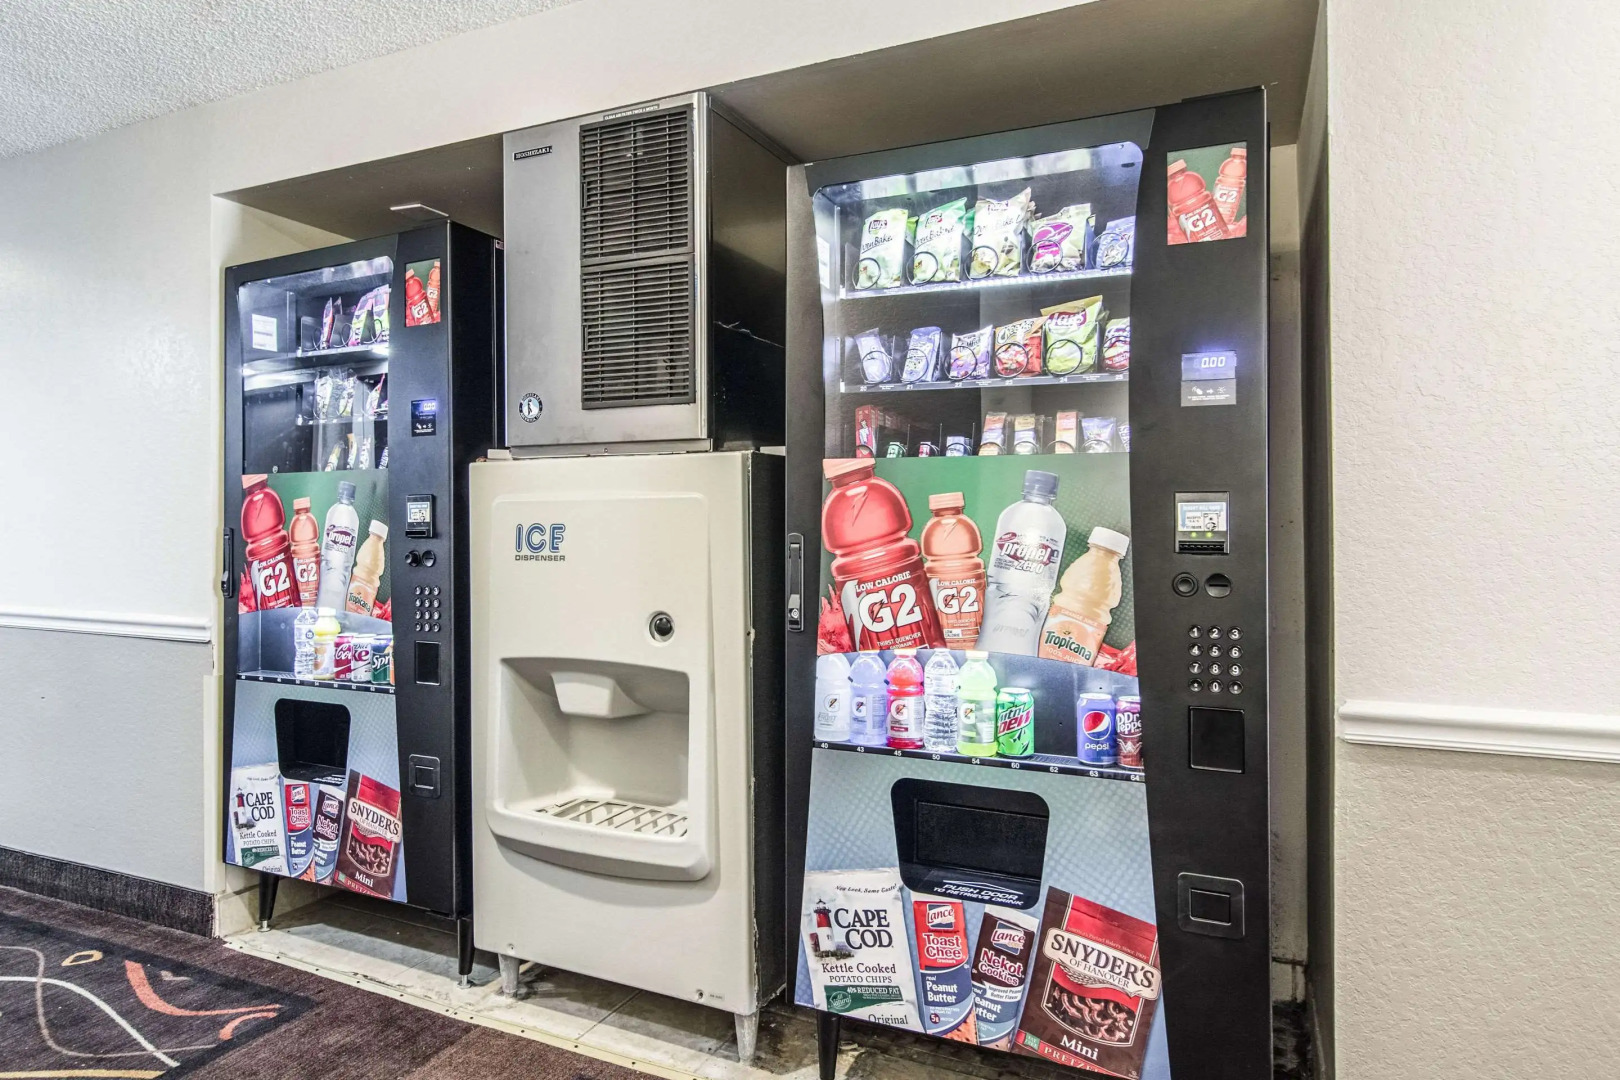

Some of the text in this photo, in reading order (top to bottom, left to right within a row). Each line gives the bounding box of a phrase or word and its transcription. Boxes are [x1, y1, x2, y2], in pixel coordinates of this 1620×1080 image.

[1217, 189, 1238, 203] G2
[1187, 208, 1217, 232] G2
[515, 523, 566, 553] ICE
[515, 554, 566, 562] DISPENSER
[1000, 542, 1052, 562] propel
[297, 562, 318, 583] G2
[1015, 559, 1045, 574] zero
[260, 561, 291, 597] G2
[855, 570, 912, 592] LOW CALORIE
[951, 578, 976, 586] CALORIE
[348, 592, 371, 613] Tropicana
[859, 584, 923, 633] G2
[937, 586, 979, 615] G2
[877, 631, 922, 647] THIRST QUENCHER
[1192, 628, 1239, 639] 1 2 3
[1043, 630, 1092, 661] Tropicana
[1192, 645, 1239, 657] 4 5 6
[1193, 663, 1239, 674] 7 8 9
[1212, 682, 1219, 691] 0
[852, 696, 867, 718] G
[890, 699, 909, 721] G
[961, 703, 977, 724] G
[1124, 711, 1140, 723] Dr
[1084, 742, 1110, 752] pepsi
[246, 791, 274, 808] CAPE
[251, 806, 275, 822] COD
[289, 806, 308, 817] Toast
[350, 801, 400, 836] SNYDER'S
[290, 815, 308, 826] Chee
[316, 815, 339, 834] Nekot
[240, 830, 277, 840] Kettle Cooked
[355, 870, 374, 888] Mini
[943, 884, 1019, 901] PUSH DOOR
[946, 888, 992, 901] RETRIEVE
[991, 896, 1024, 906] DRINK
[834, 907, 890, 929] CAPE
[927, 907, 954, 924] Lance
[845, 928, 893, 950] COD
[923, 933, 961, 948] Toast
[991, 929, 1026, 944] Lance
[925, 945, 961, 959] Chee
[821, 962, 897, 974] Kettle Cooked
[982, 948, 1024, 978] Nekot
[1051, 933, 1155, 989] SNYDER'S
[829, 975, 893, 984] POTATO CHIPS
[979, 961, 1020, 986] Cookies
[1069, 957, 1131, 989] OF HANOVER
[846, 986, 900, 995] 40% REDUCED FAT
[926, 981, 958, 993] Peanut
[927, 991, 957, 1003] Butter
[868, 1013, 909, 1026] Original
[1060, 1034, 1099, 1060] Mini
